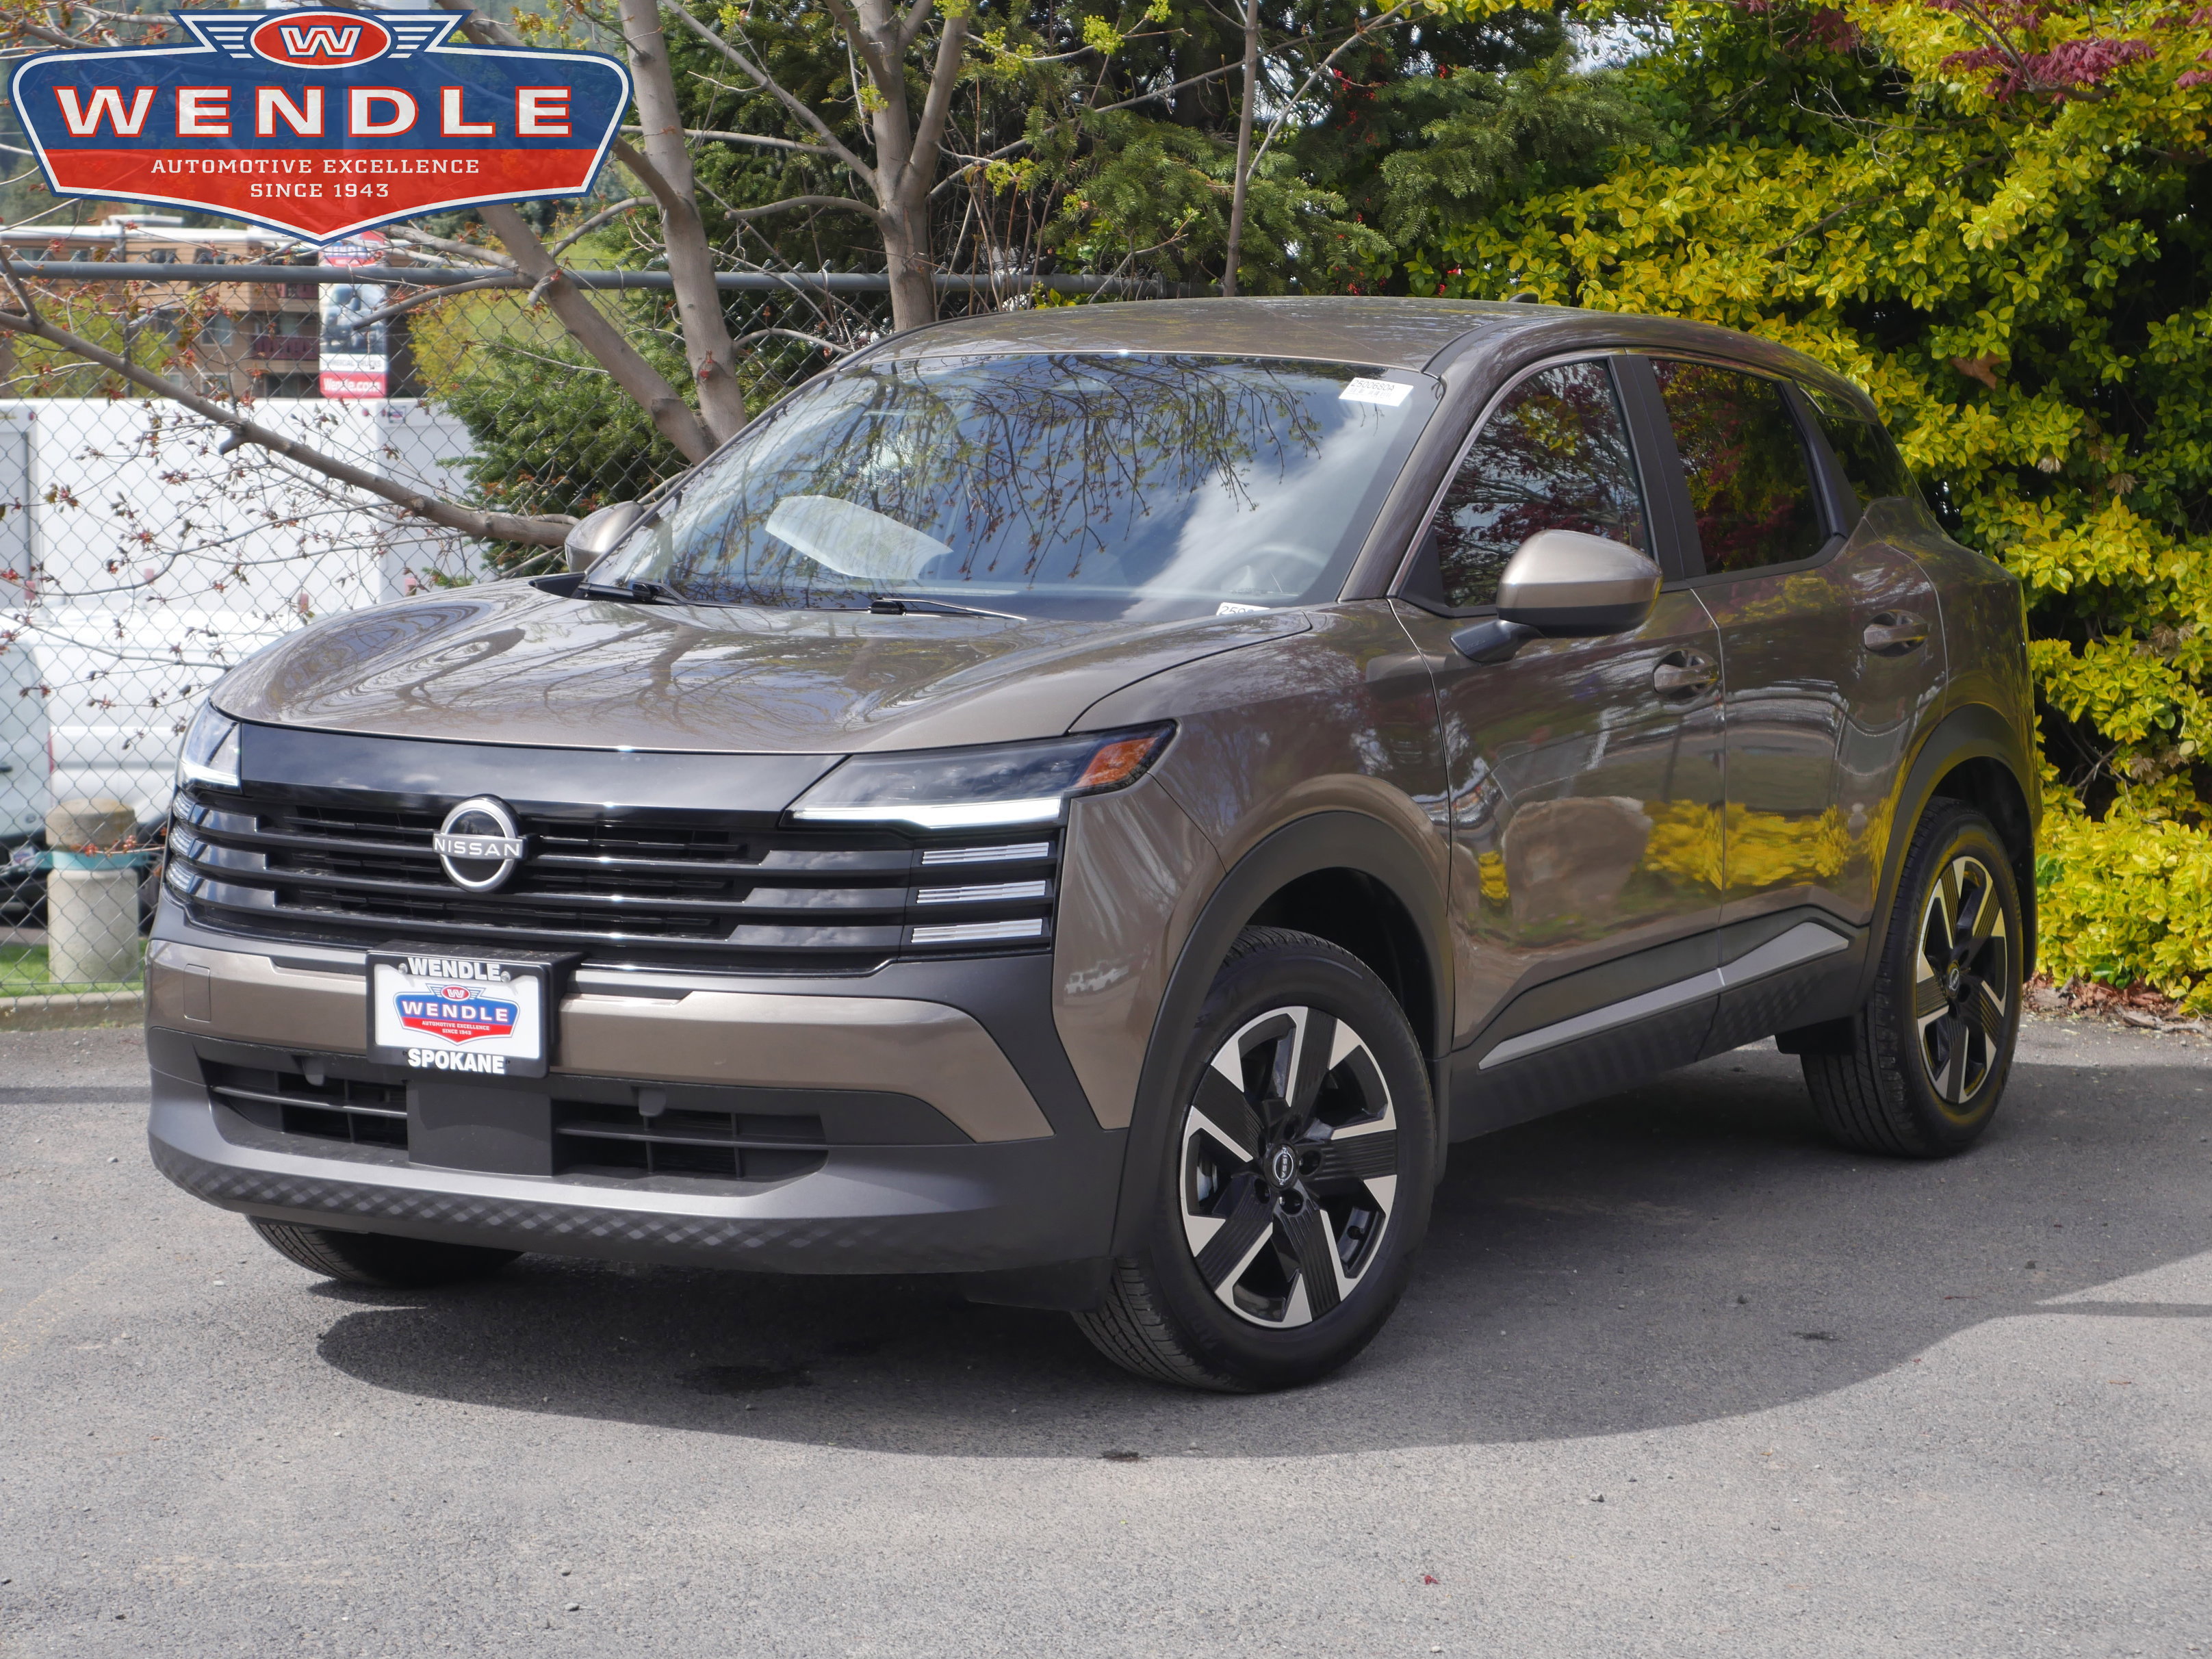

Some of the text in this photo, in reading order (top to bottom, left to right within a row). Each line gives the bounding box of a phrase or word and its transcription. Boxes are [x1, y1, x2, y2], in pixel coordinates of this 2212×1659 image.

[434, 837, 520, 856] NISSAN
[407, 957, 502, 982] WENDLE
[401, 1001, 509, 1023] WENDLE
[456, 1023, 490, 1031] EXCELLENCE
[408, 1048, 505, 1075] SPOKANE
